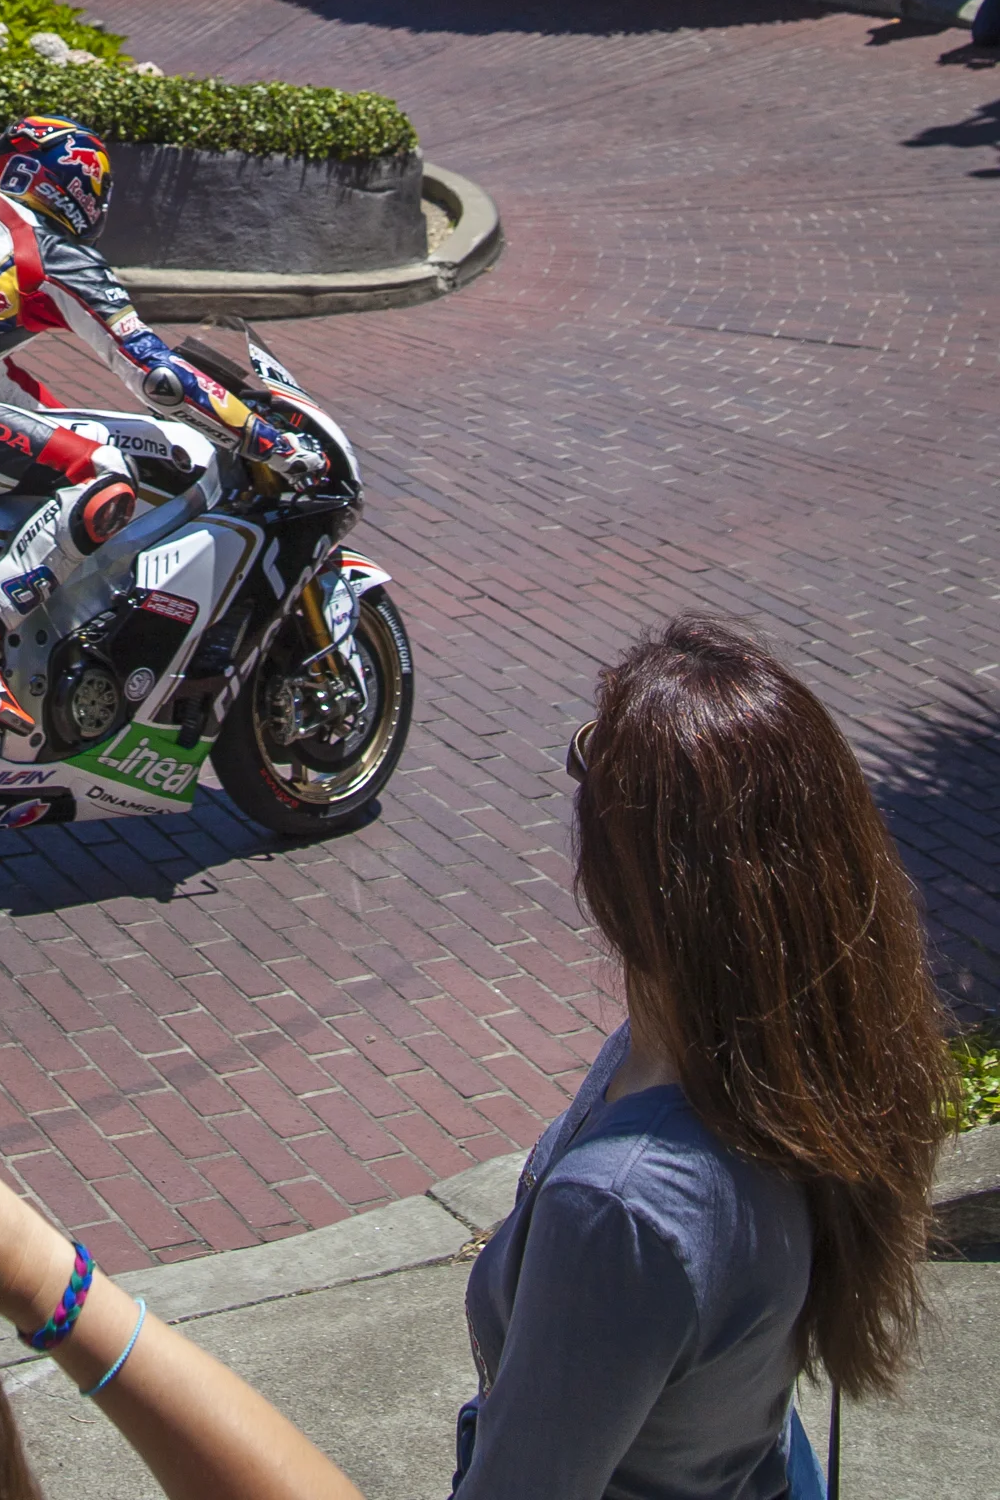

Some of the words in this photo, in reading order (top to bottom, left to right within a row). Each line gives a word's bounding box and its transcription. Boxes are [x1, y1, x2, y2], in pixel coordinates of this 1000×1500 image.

[35, 182, 88, 234] SHARK
[106, 429, 168, 458] rizoma
[97, 724, 201, 795] Linear
